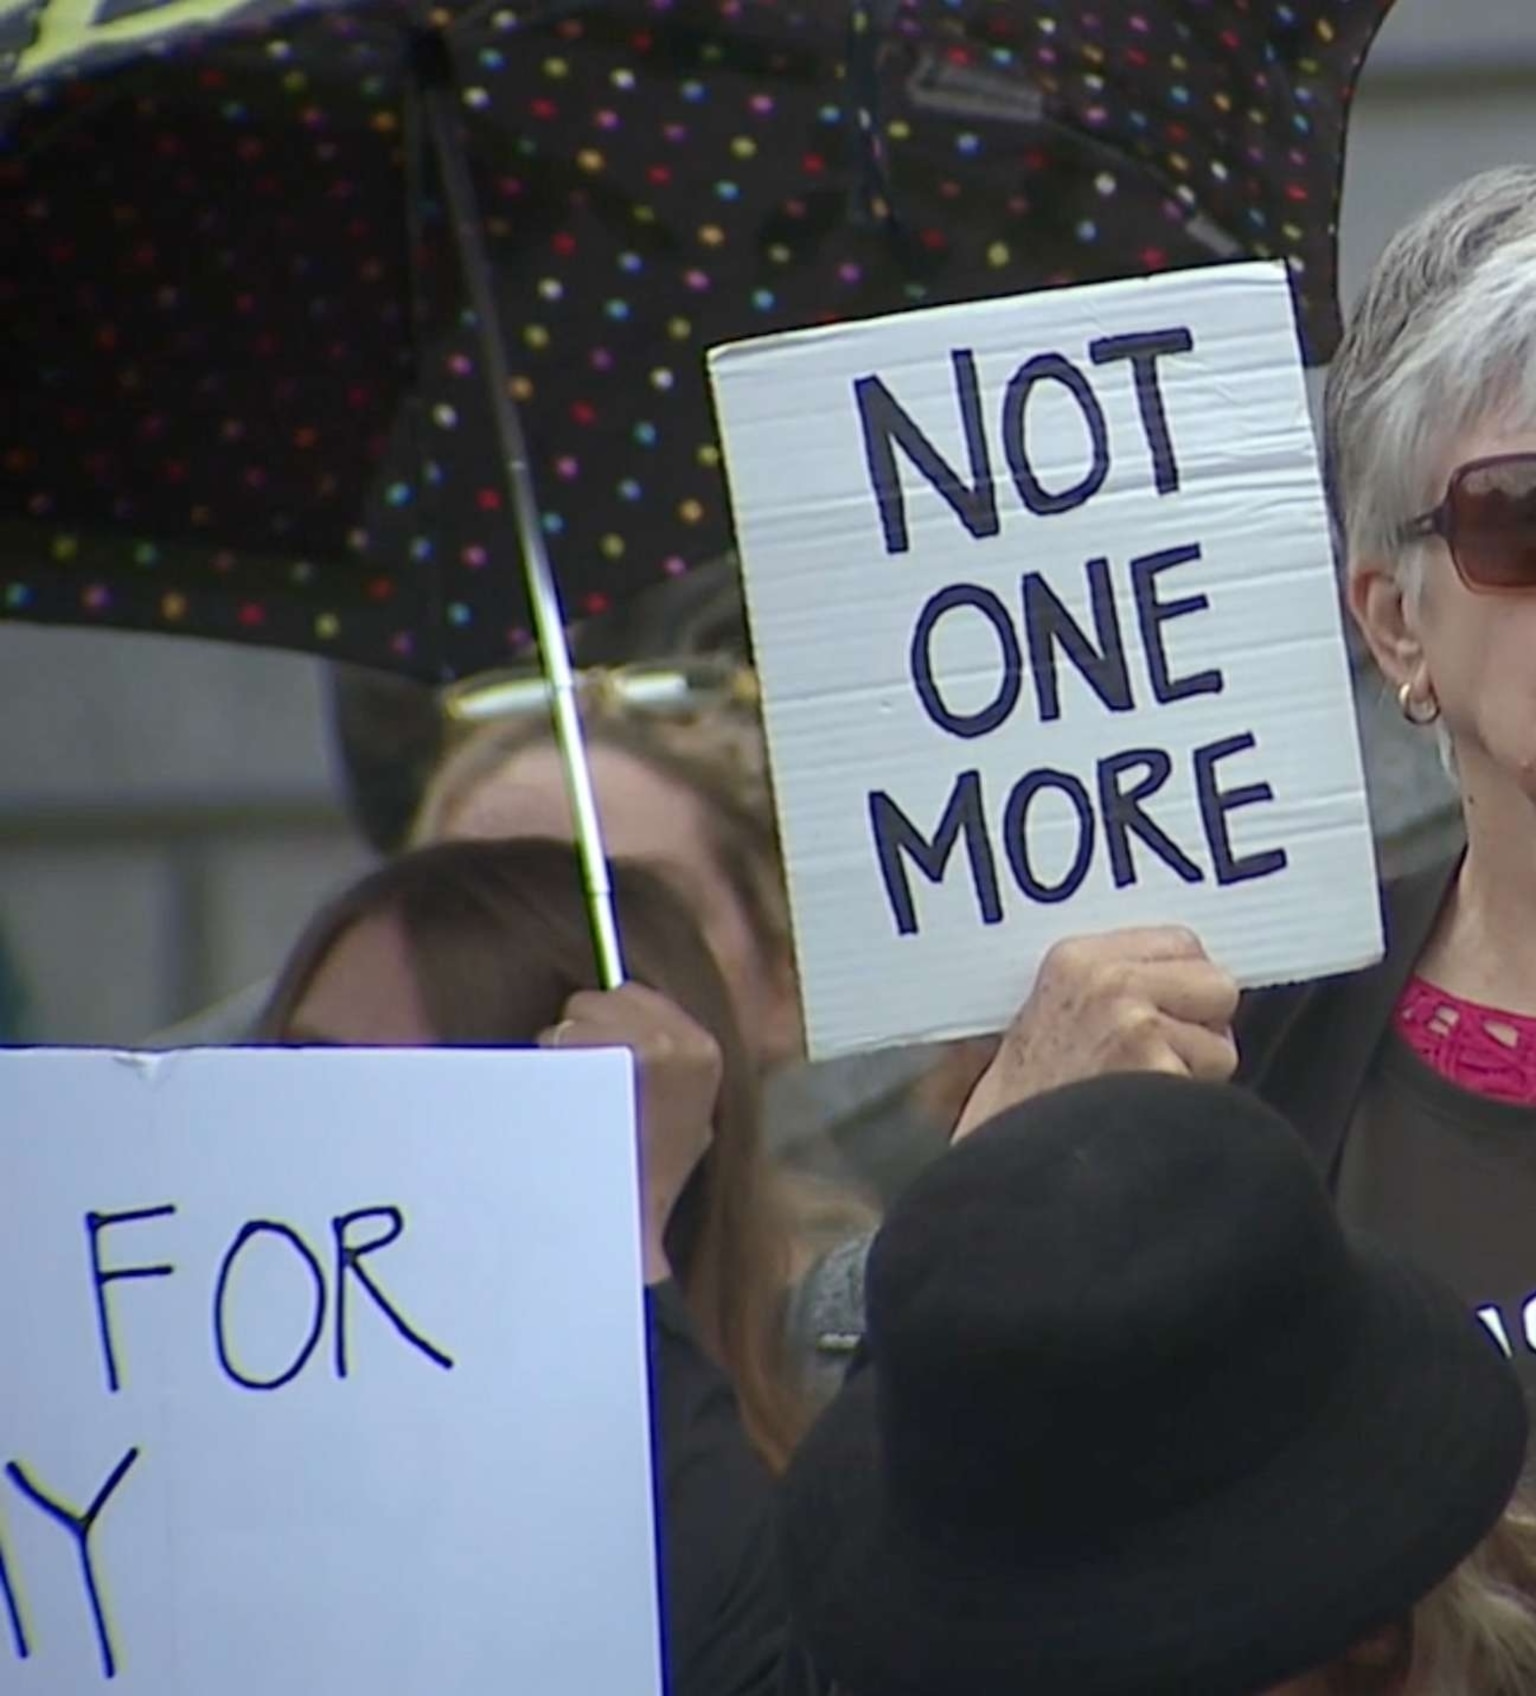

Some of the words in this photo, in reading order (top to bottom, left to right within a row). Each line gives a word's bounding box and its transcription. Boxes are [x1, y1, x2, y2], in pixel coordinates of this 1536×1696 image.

[853, 327, 1194, 553] NOT
[911, 543, 1223, 738] ONE
[868, 731, 1288, 935] MORE
[86, 1204, 454, 1392] FOR
[0, 1446, 139, 1680] Y
